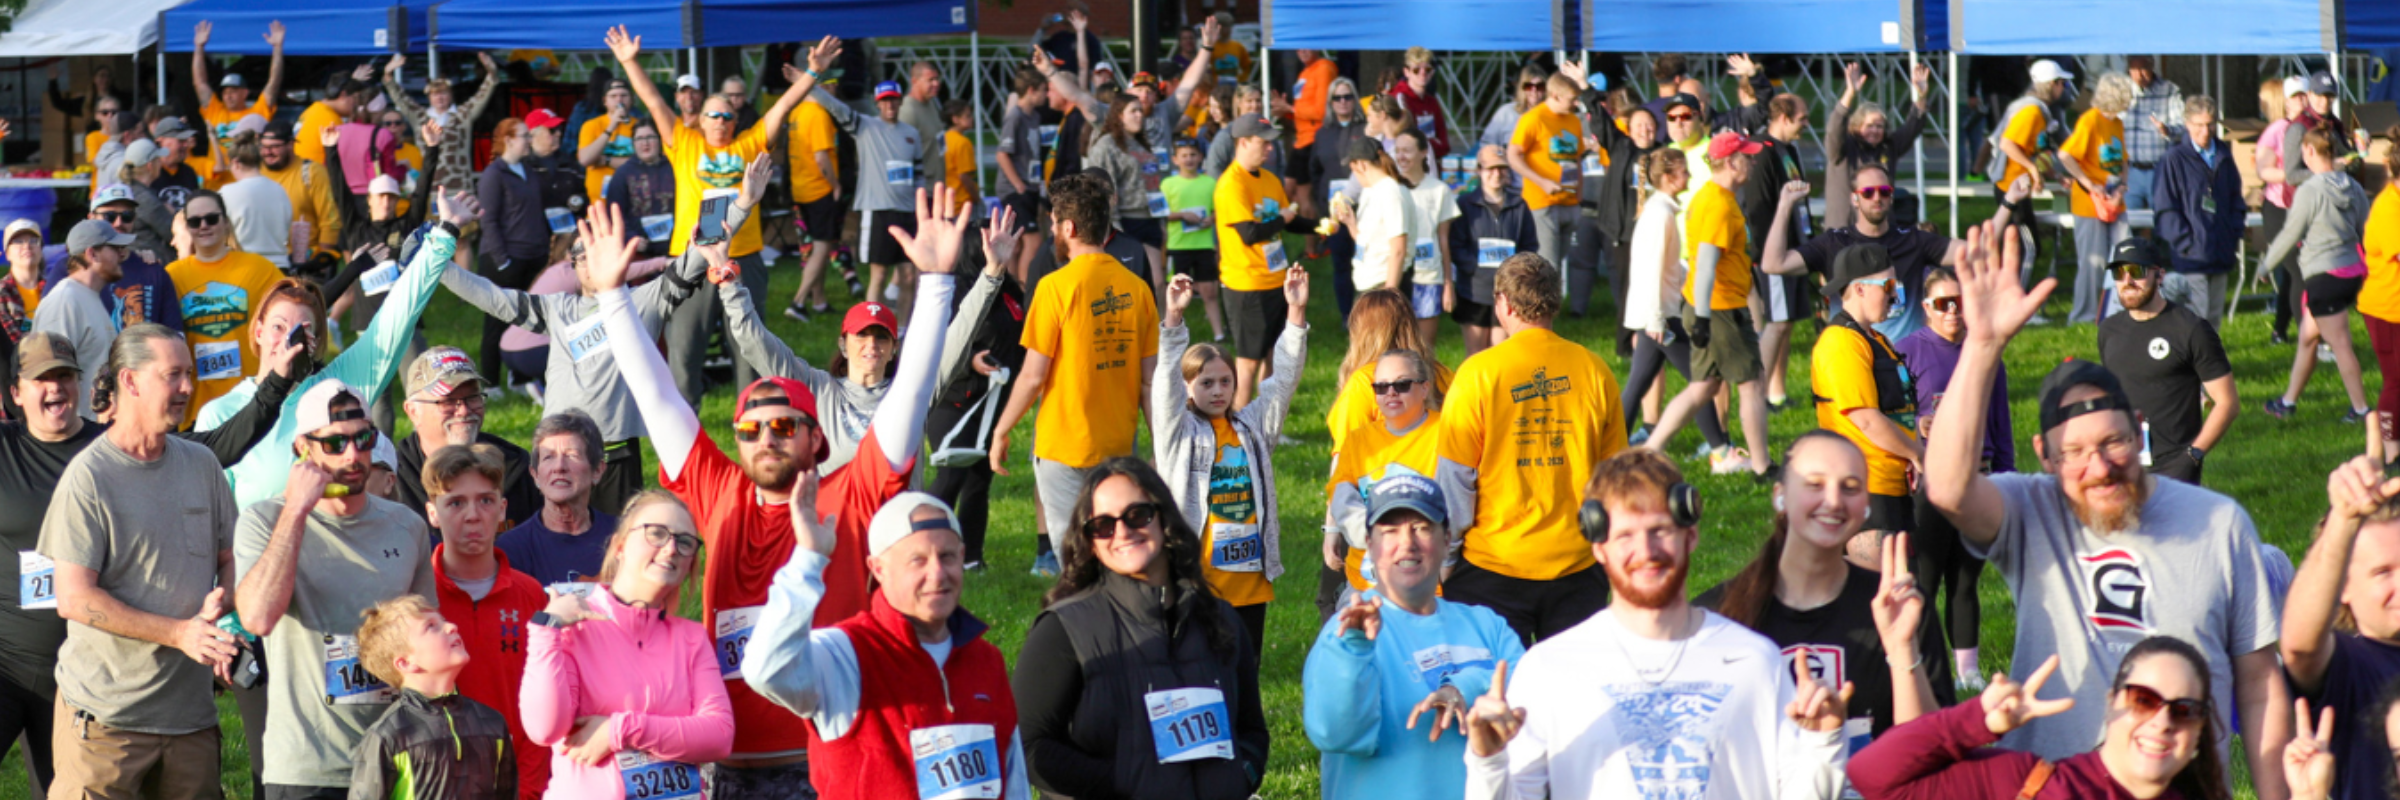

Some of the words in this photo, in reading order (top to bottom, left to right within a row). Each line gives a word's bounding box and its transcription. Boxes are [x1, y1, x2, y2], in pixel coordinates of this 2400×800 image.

[867, 304, 882, 316] P
[202, 353, 235, 373] 2841
[1221, 539, 1257, 562] 1537
[2093, 562, 2146, 623] G
[1167, 710, 1220, 748] 1179
[631, 764, 691, 799] 3248
[929, 749, 987, 788] 1180
